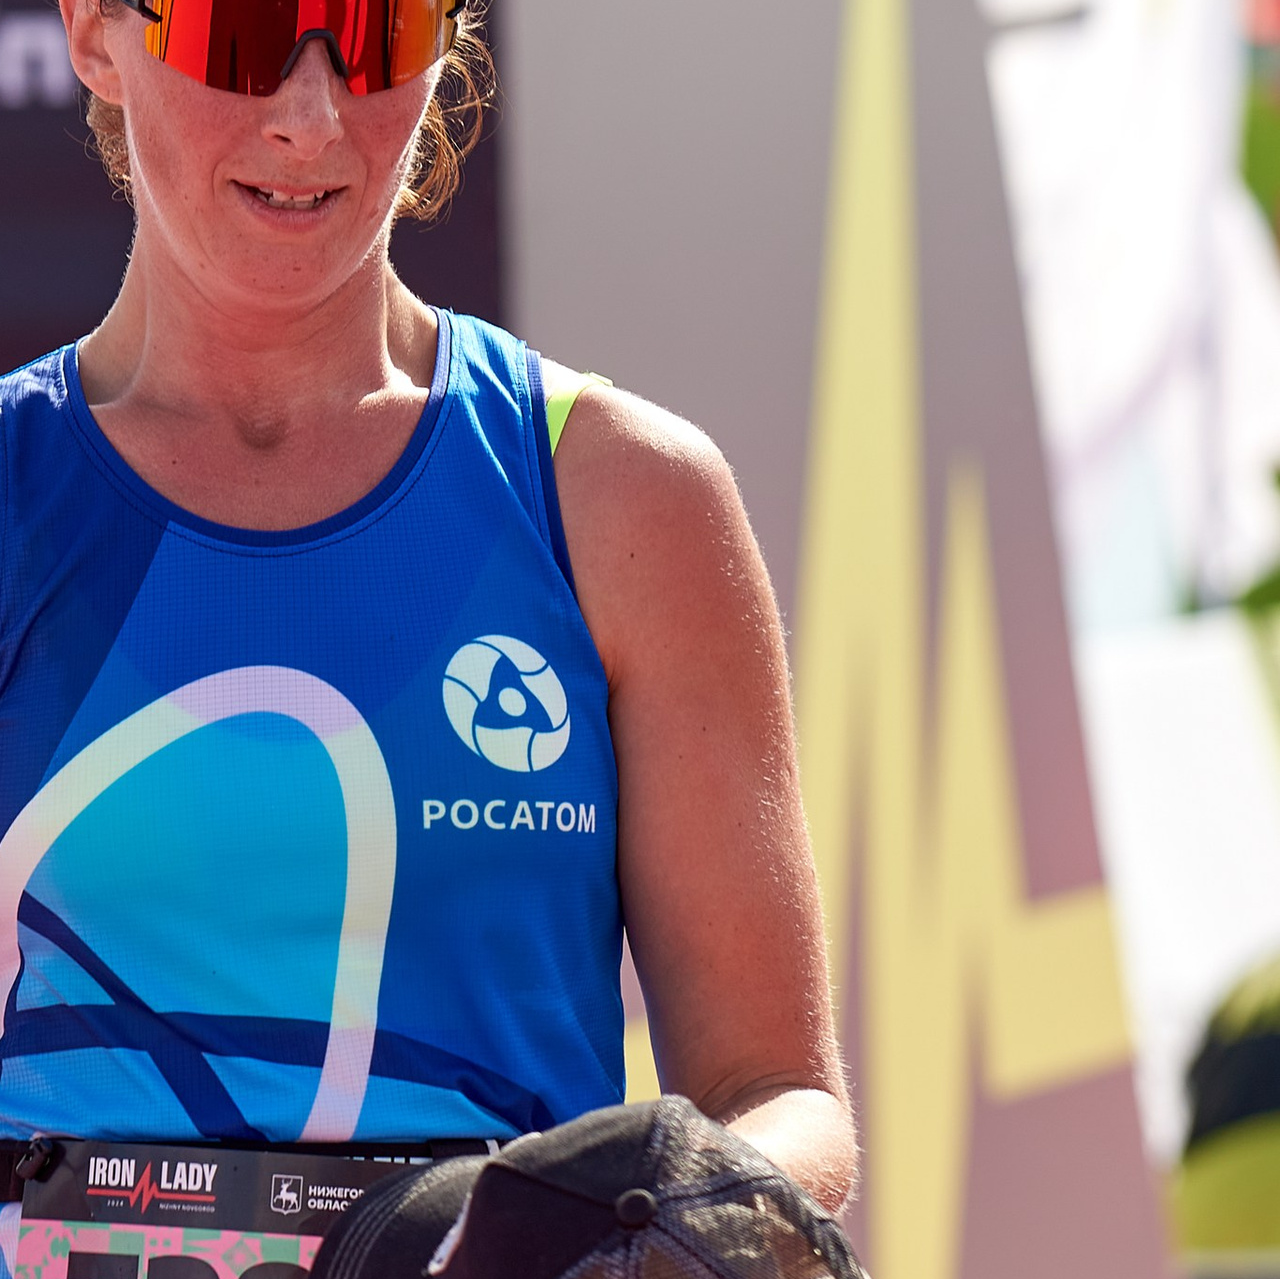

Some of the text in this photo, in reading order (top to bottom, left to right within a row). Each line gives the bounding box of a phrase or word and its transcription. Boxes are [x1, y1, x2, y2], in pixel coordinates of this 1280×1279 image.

[422, 798, 596, 834] РОСАТОМ
[88, 1156, 218, 1192] IRON LADY
[307, 1198, 352, 1212] ОБЛАС
